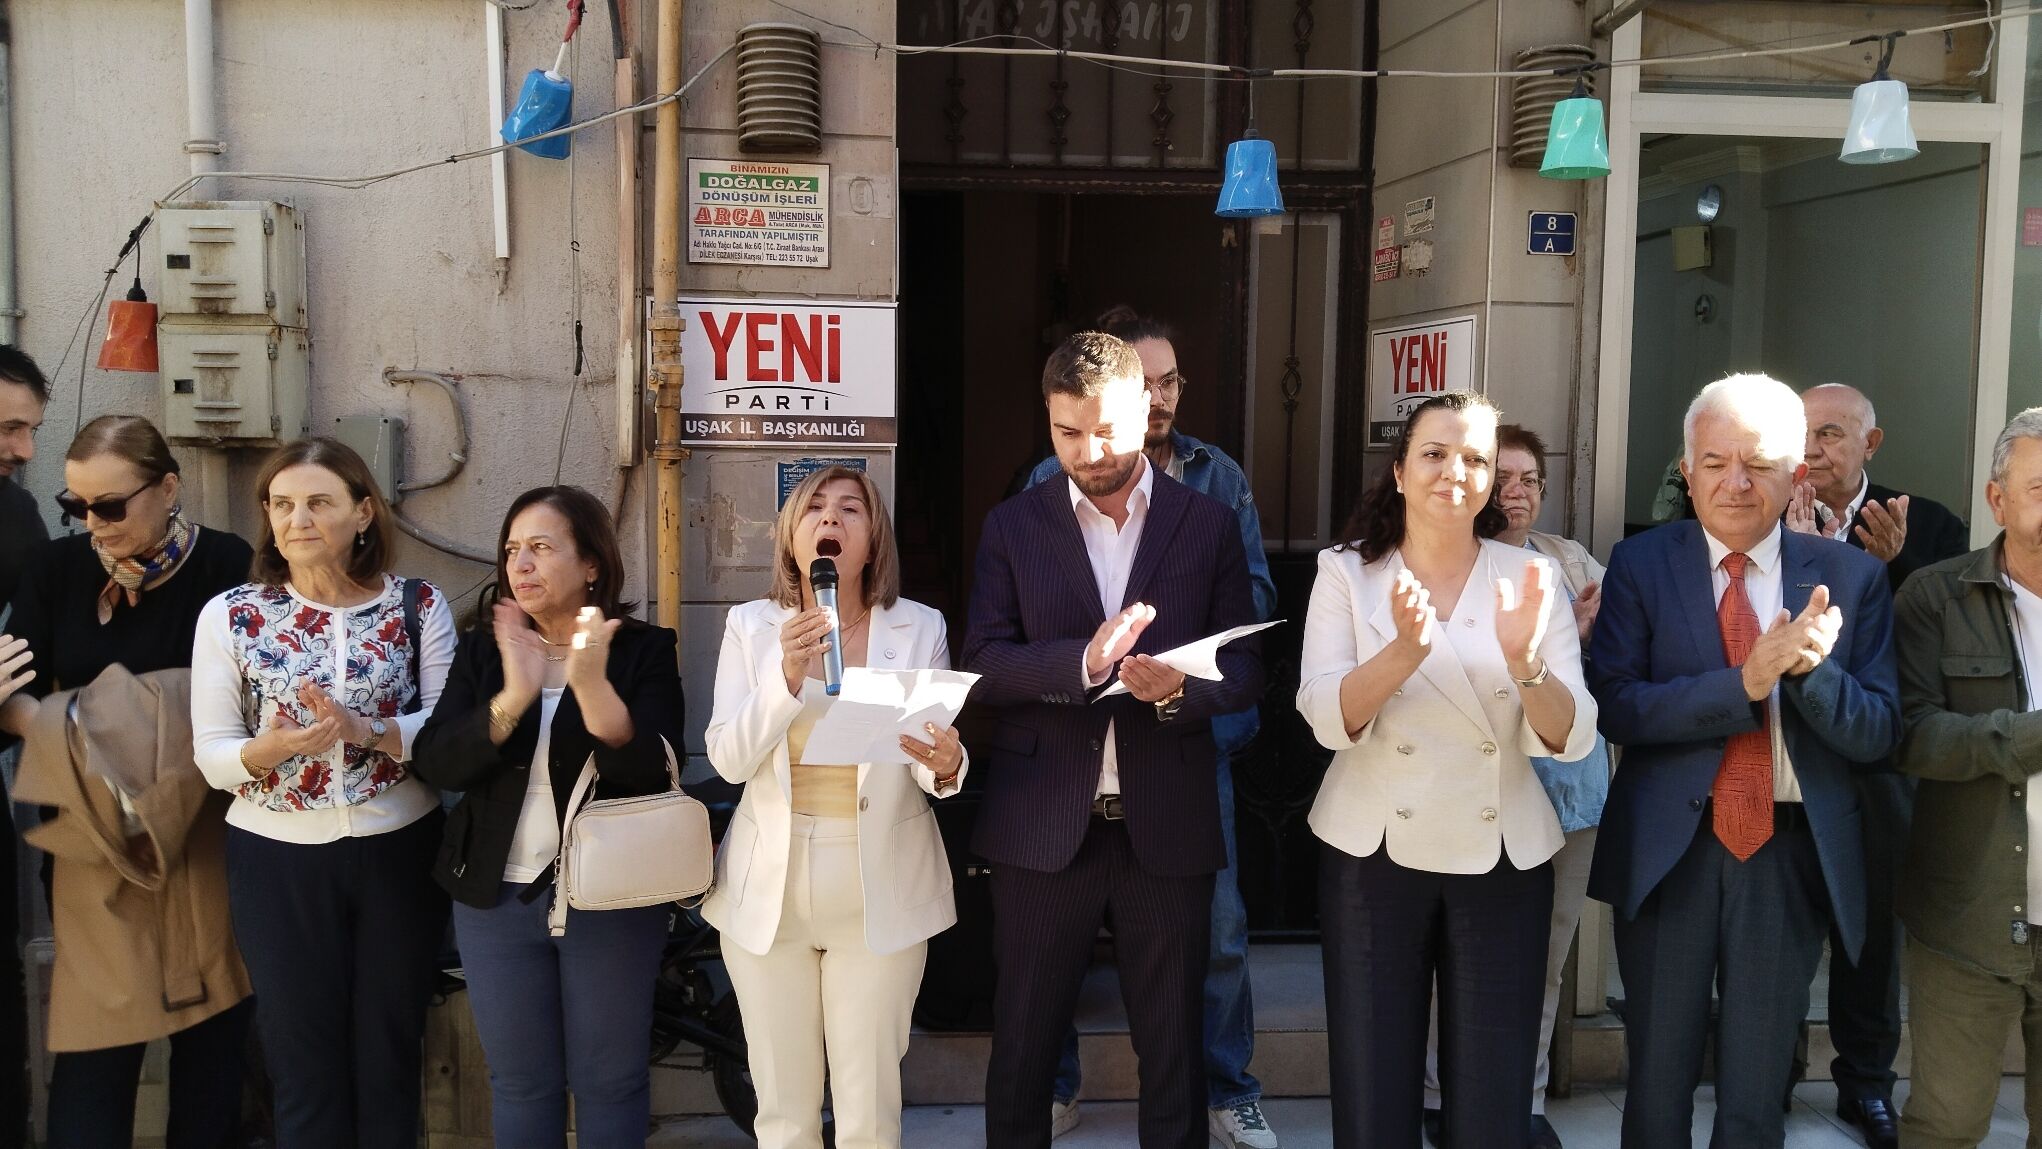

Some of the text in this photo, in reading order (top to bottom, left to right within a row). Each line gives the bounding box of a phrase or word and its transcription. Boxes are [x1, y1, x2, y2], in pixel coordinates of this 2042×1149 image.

[730, 164, 789, 174] BİNAMIZIN
[707, 175, 811, 191] DOĞALGAZ
[702, 191, 817, 205] DÖNÜŞÜM İŞLERİ
[694, 206, 823, 227] ARCA MÜHENDİSLİK
[1547, 216, 1557, 231] 8
[699, 229, 819, 243] TARAFINDAN YAPILMIŞTIR
[776, 243, 791, 252] Ziraat
[1544, 237, 1555, 252] A
[716, 251, 743, 260] ECZANESİ
[778, 253, 788, 261] 223
[685, 418, 866, 439] UŞAK İL BAŞKANLIĞI
[1381, 425, 1400, 440] UŞAK
